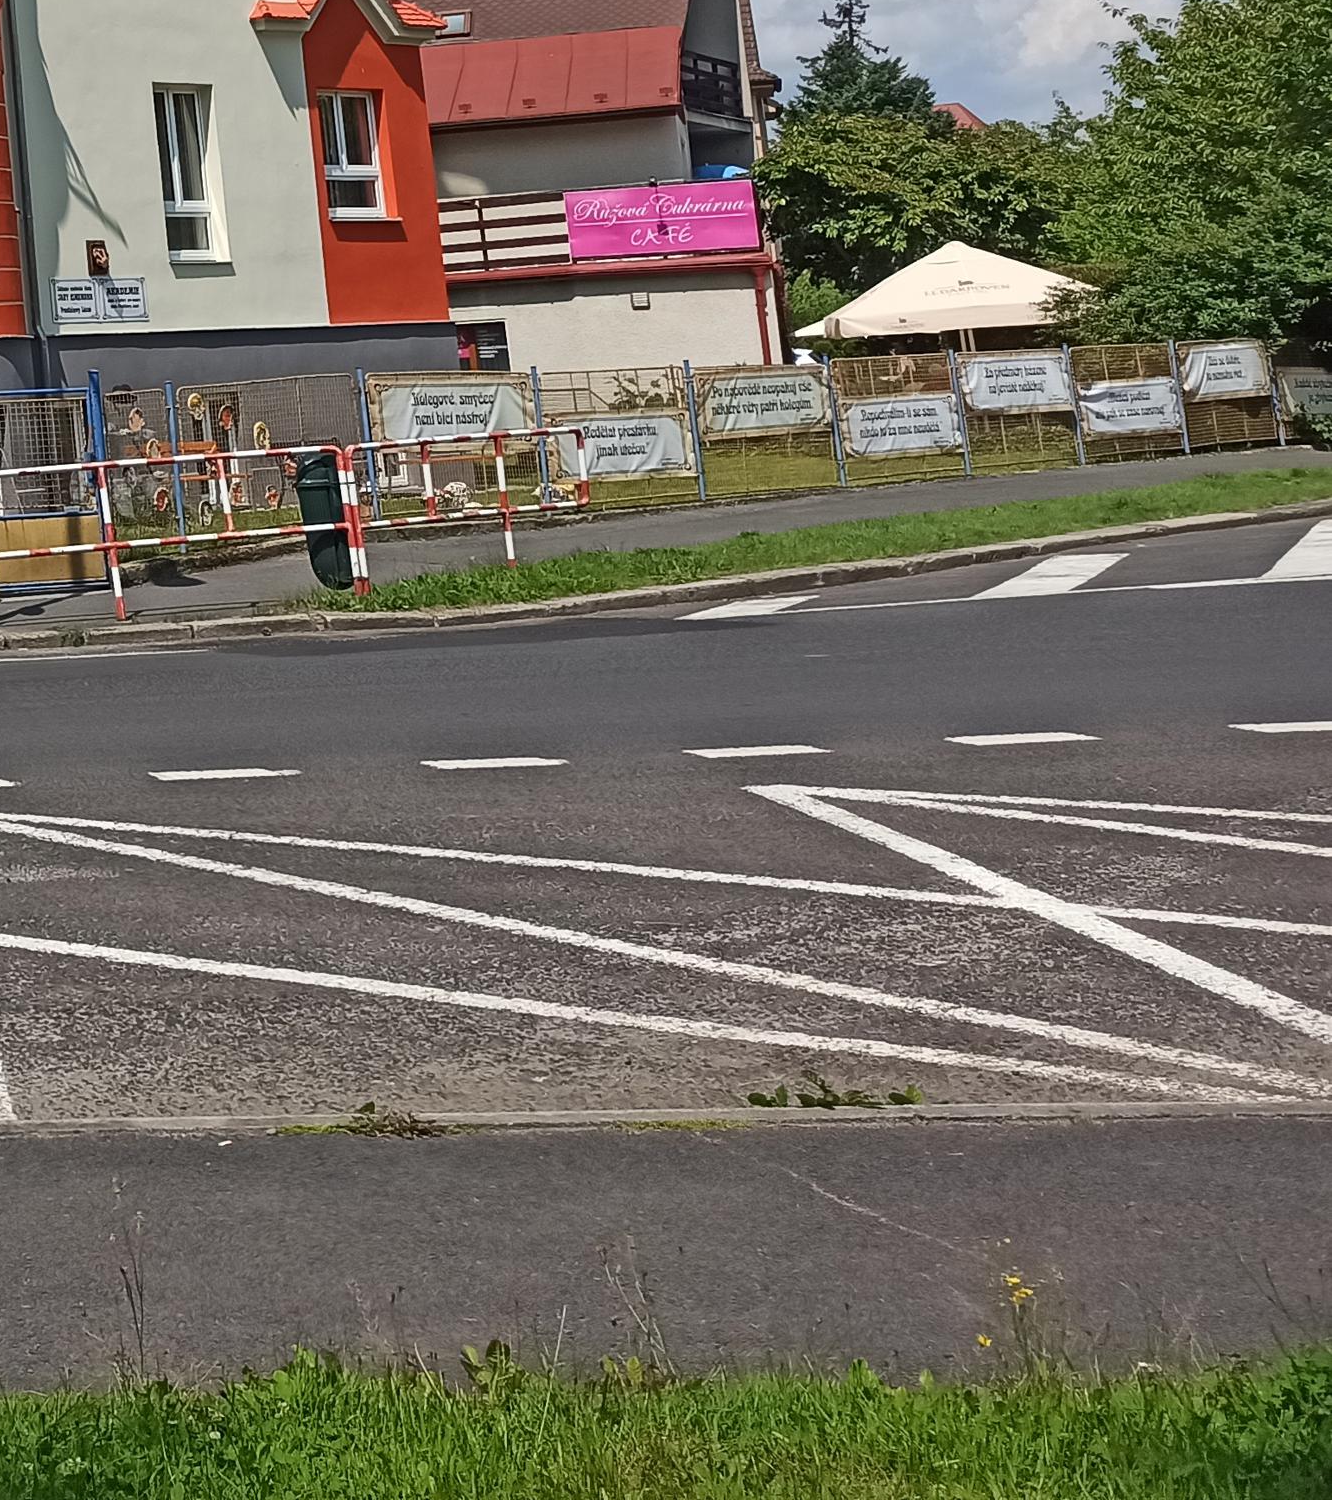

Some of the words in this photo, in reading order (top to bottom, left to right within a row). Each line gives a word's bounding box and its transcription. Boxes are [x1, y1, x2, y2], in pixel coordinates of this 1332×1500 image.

[573, 197, 648, 227] Růžová
[649, 193, 747, 217] Cukrárna
[630, 223, 694, 247] CAFÉ
